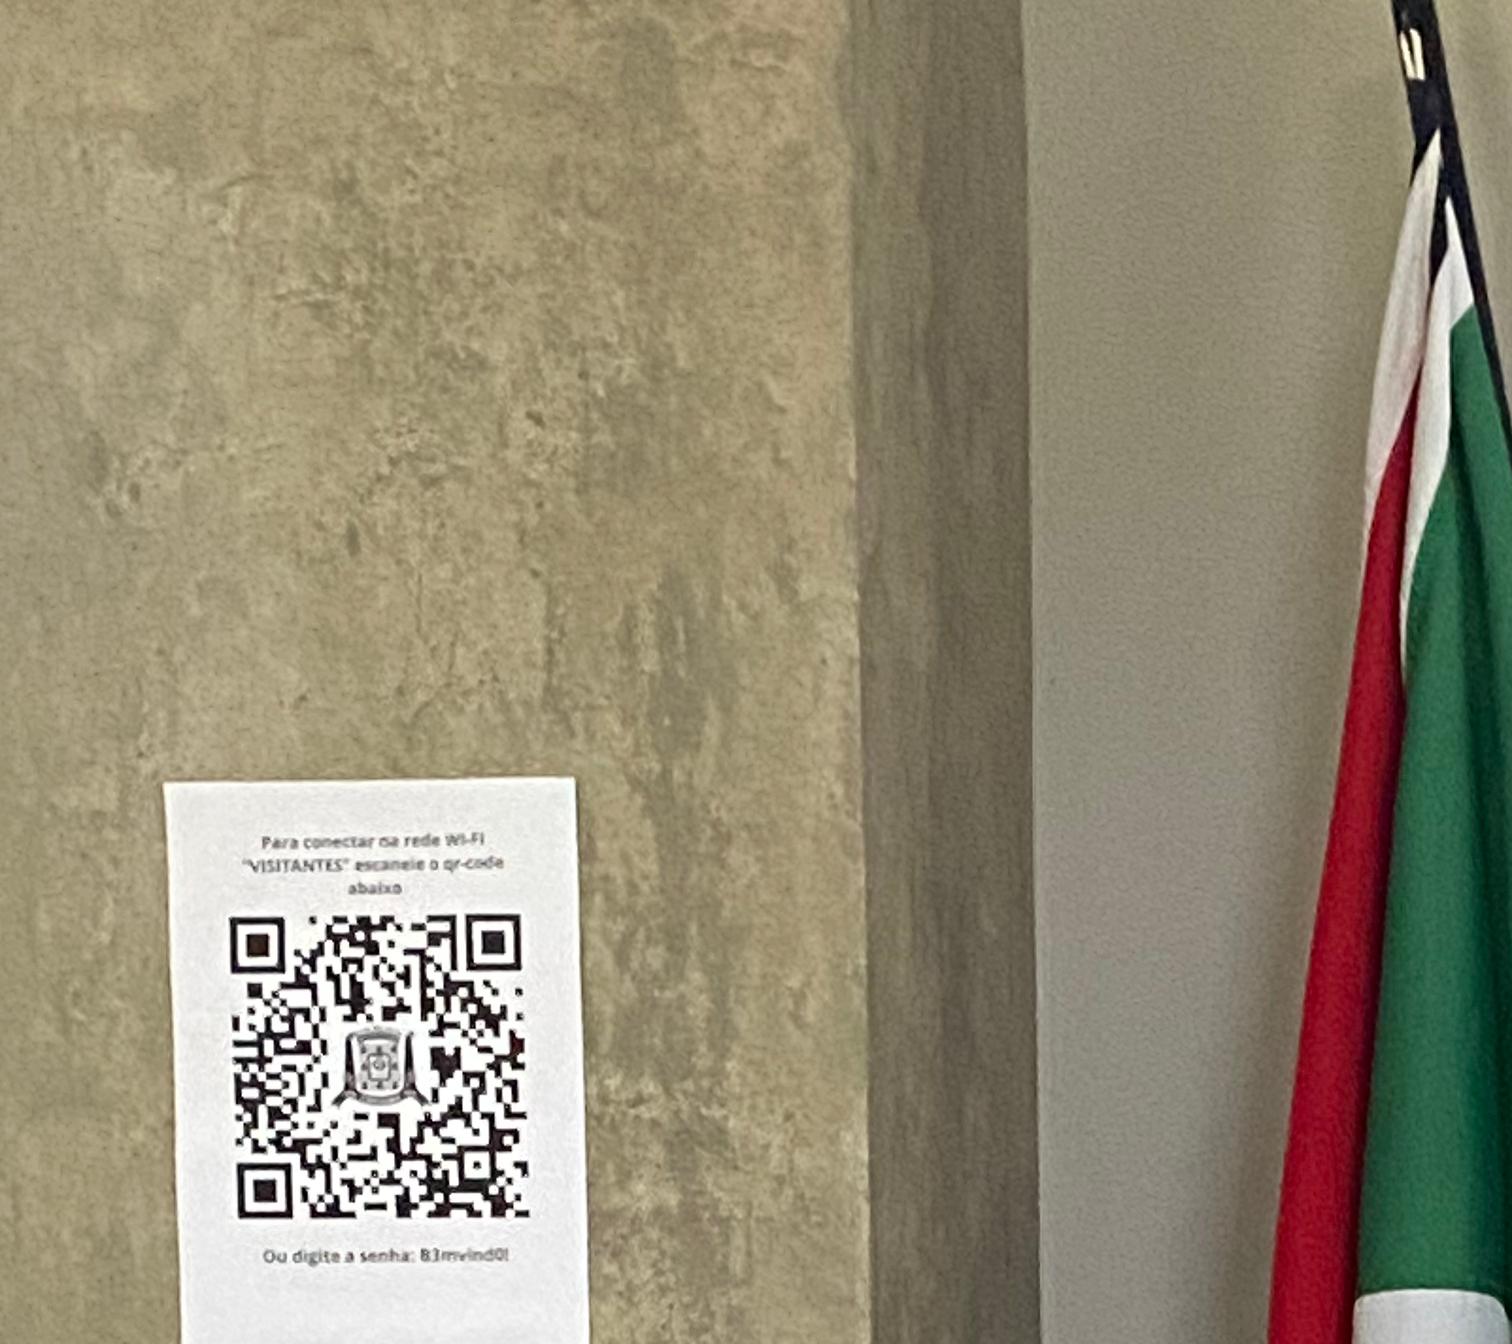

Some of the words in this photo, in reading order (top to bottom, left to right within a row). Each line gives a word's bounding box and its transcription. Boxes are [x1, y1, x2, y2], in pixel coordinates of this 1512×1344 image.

[261, 836, 299, 850] Para
[303, 836, 375, 849] conectar
[378, 836, 399, 848] na
[404, 833, 440, 848] rede
[355, 859, 425, 872] escaneie
[430, 860, 439, 871] o
[443, 856, 504, 874] qr-code
[348, 882, 402, 895] abaixo
[263, 1249, 287, 1264] Ou
[292, 1248, 341, 1268] digite
[345, 1252, 354, 1263] a
[360, 1250, 416, 1263] senha:
